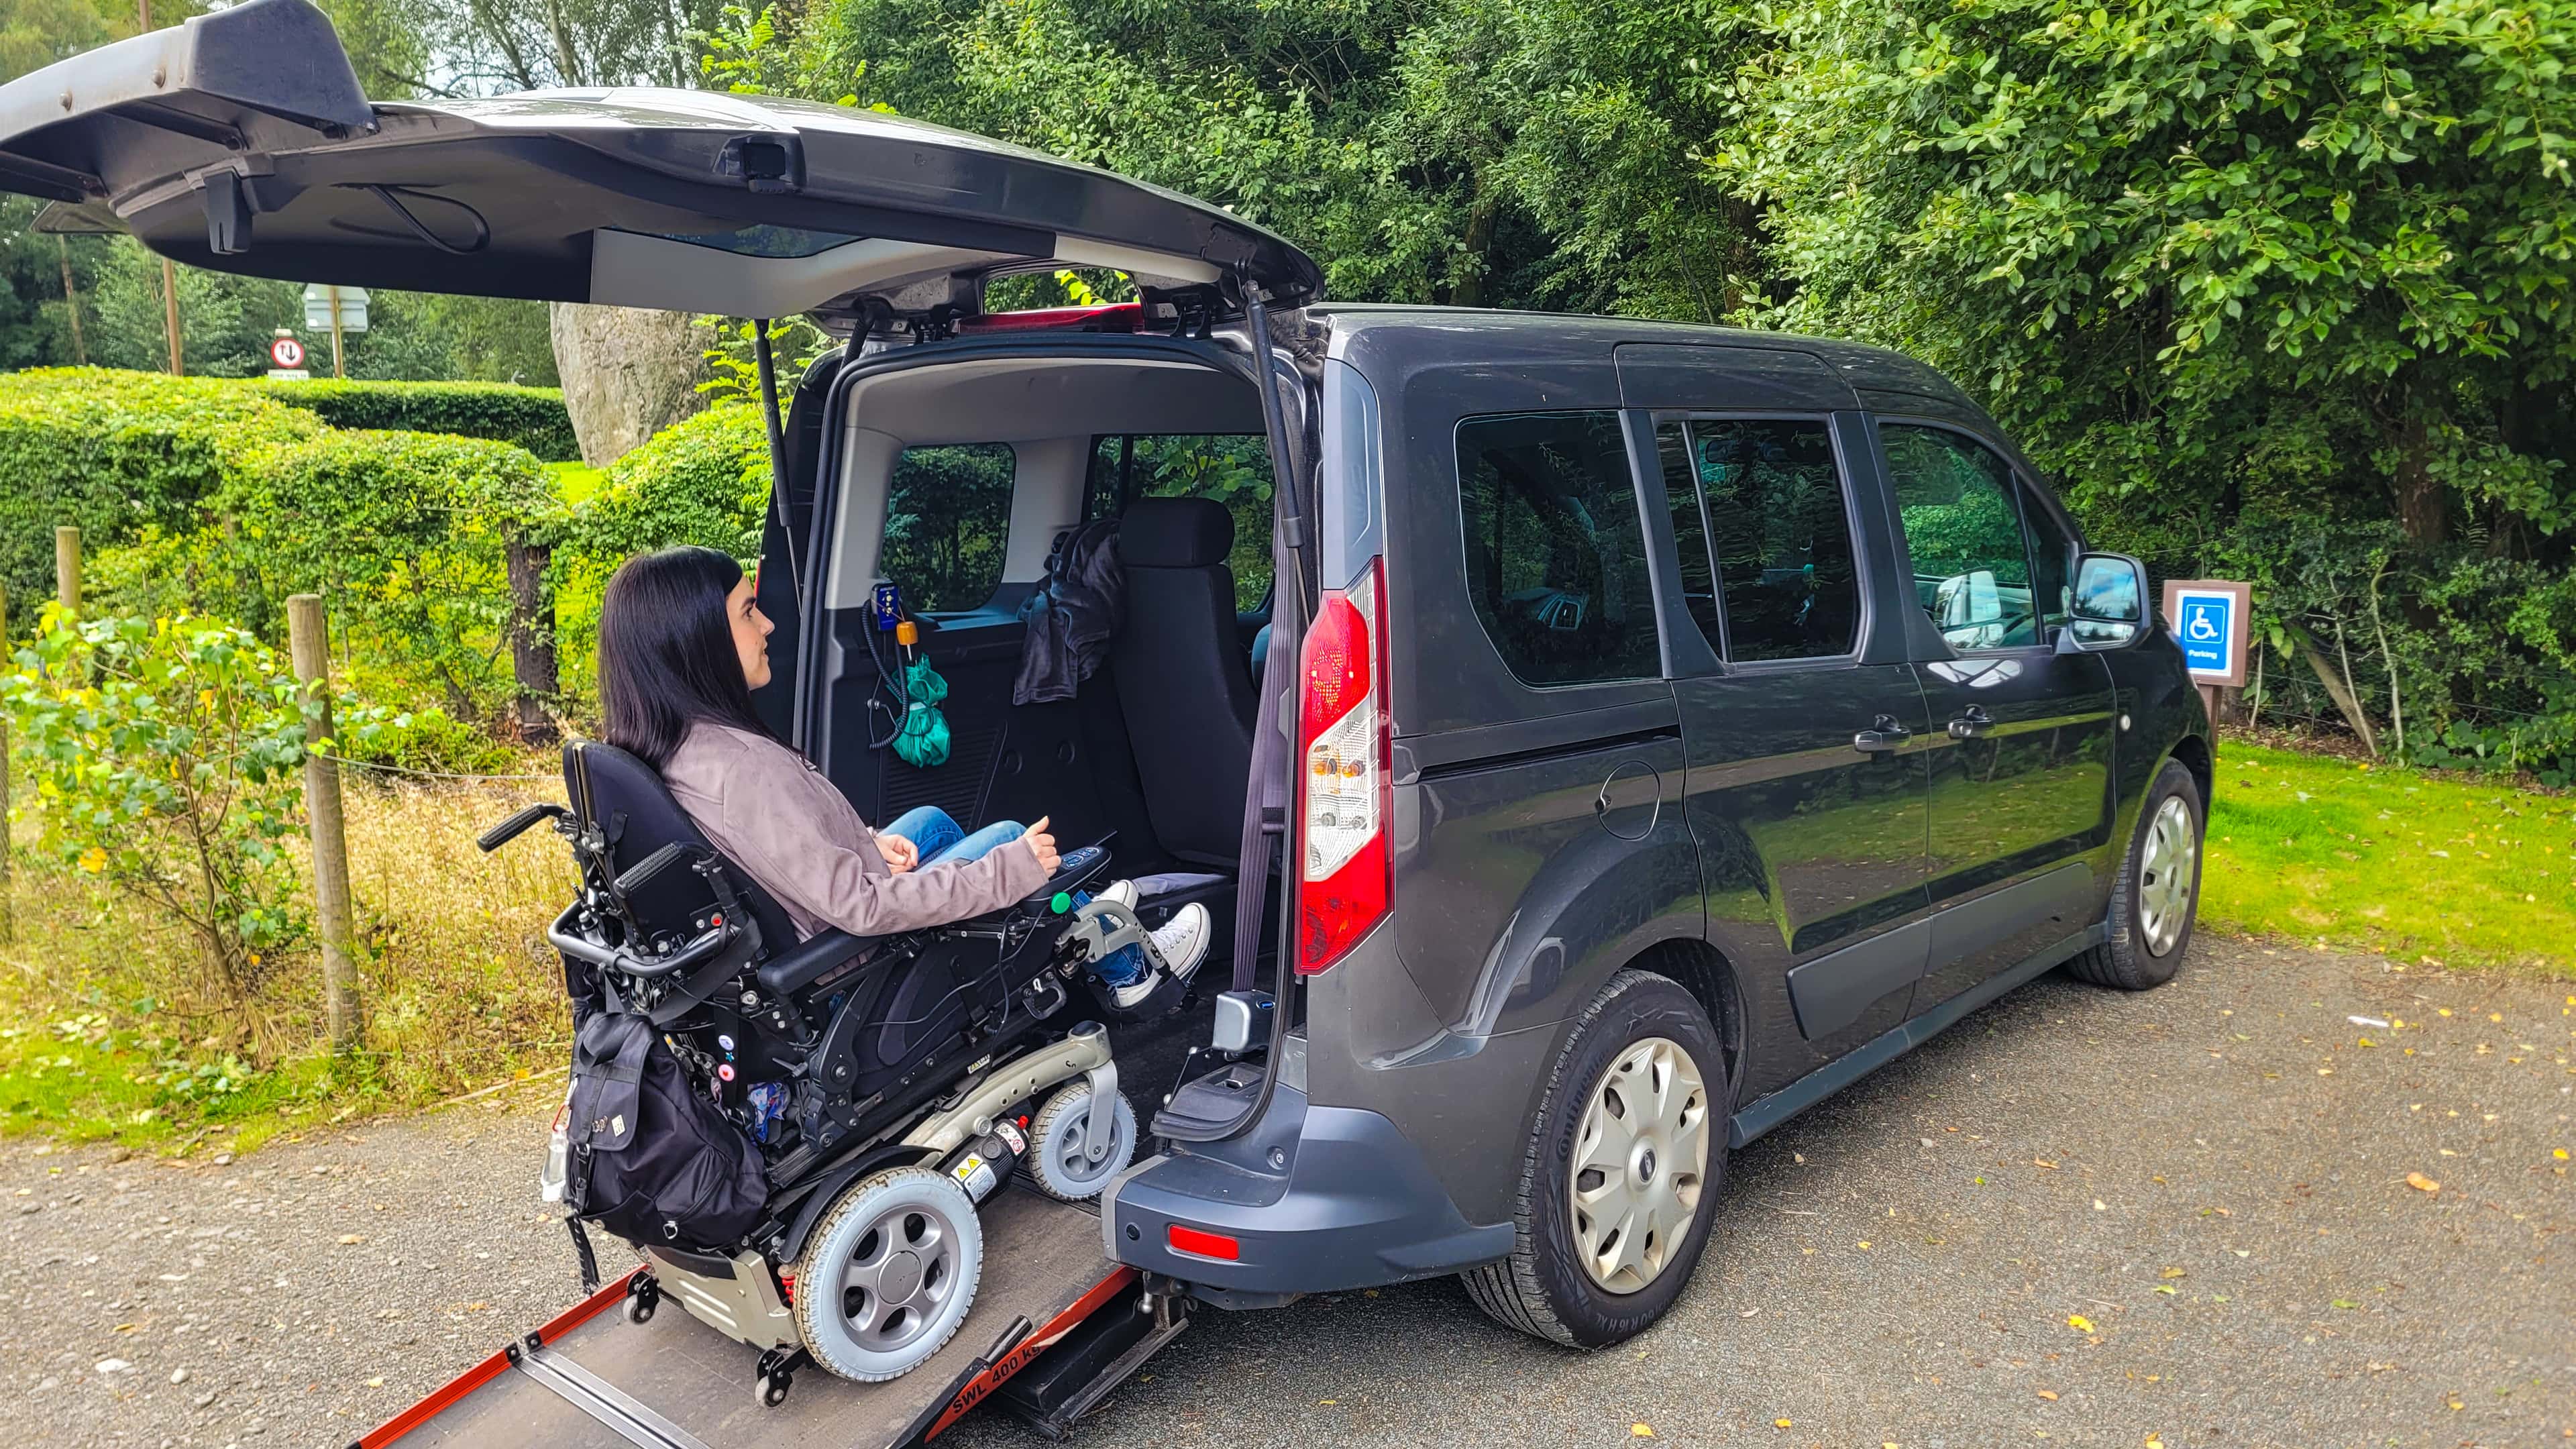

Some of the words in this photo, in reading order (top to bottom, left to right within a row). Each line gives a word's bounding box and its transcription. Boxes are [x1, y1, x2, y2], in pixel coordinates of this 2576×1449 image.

[2188, 649, 2218, 659] Parking
[953, 1384, 987, 1413] SWL
[992, 1356, 1018, 1383] 400
[1022, 1346, 1040, 1360] kg
